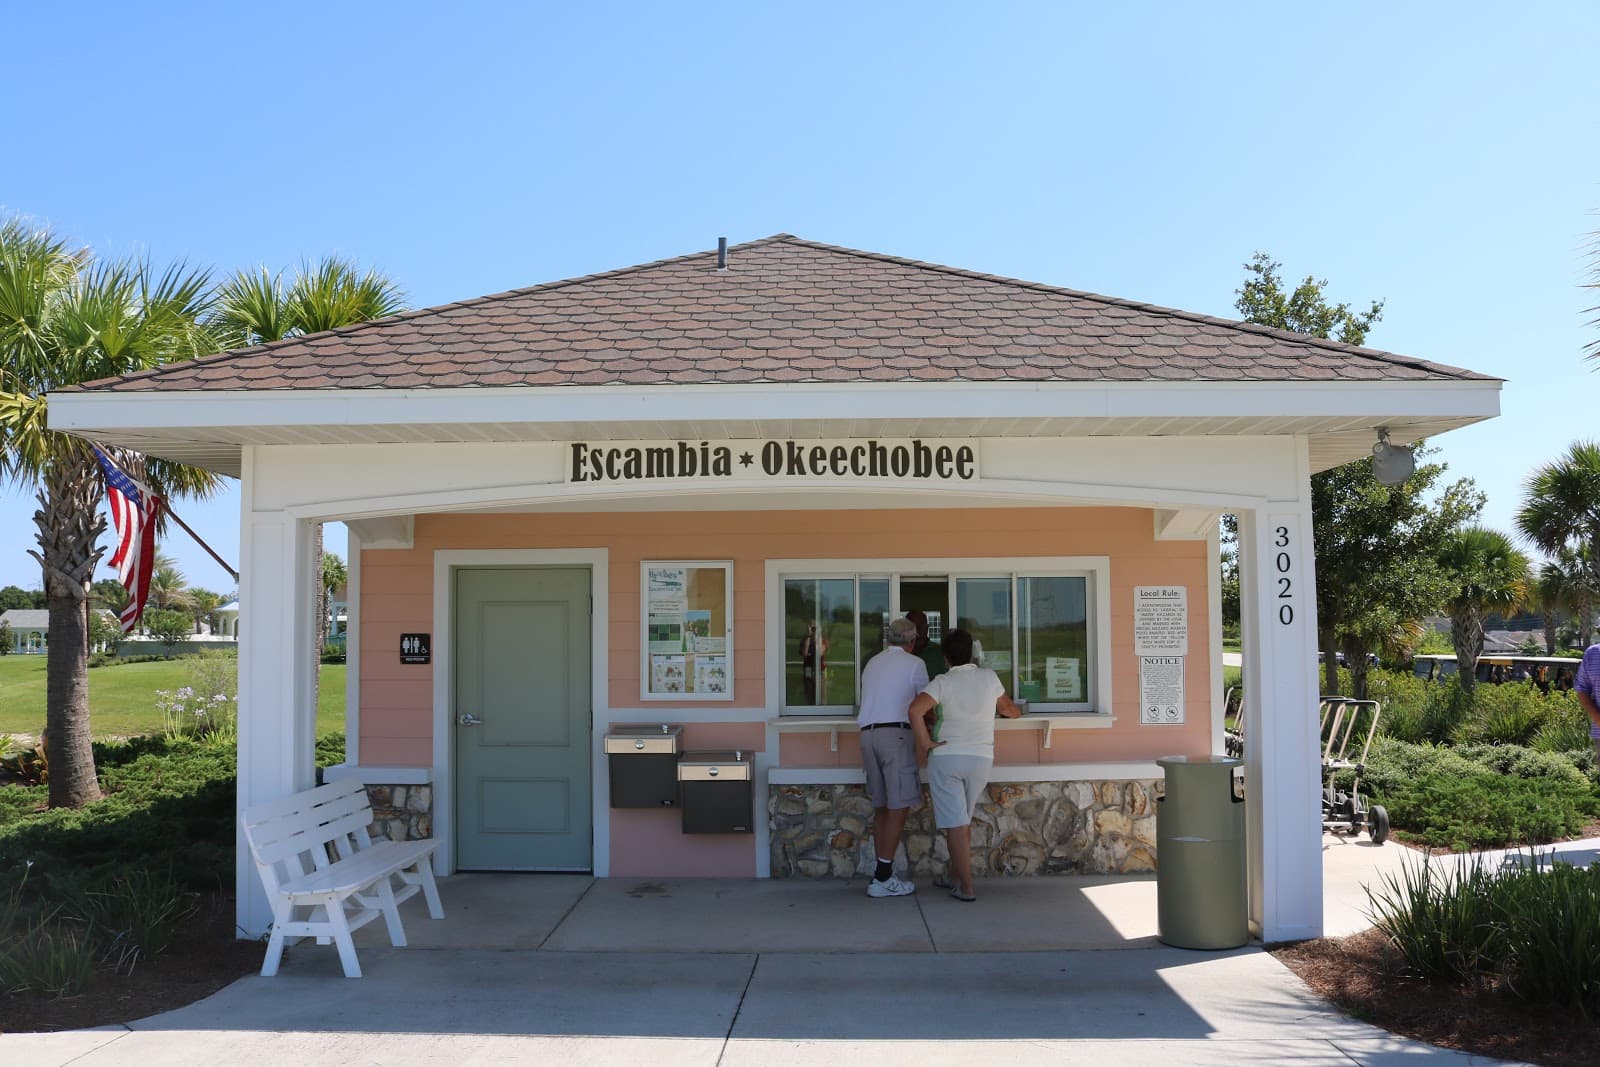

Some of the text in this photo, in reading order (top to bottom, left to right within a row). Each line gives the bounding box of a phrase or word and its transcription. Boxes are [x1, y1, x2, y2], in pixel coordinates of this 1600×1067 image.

[570, 440, 975, 482] Escambia Okeechobee
[1275, 526, 1294, 626] 3020
[1140, 589, 1159, 597] Local
[1144, 657, 1181, 665] NOTICE
